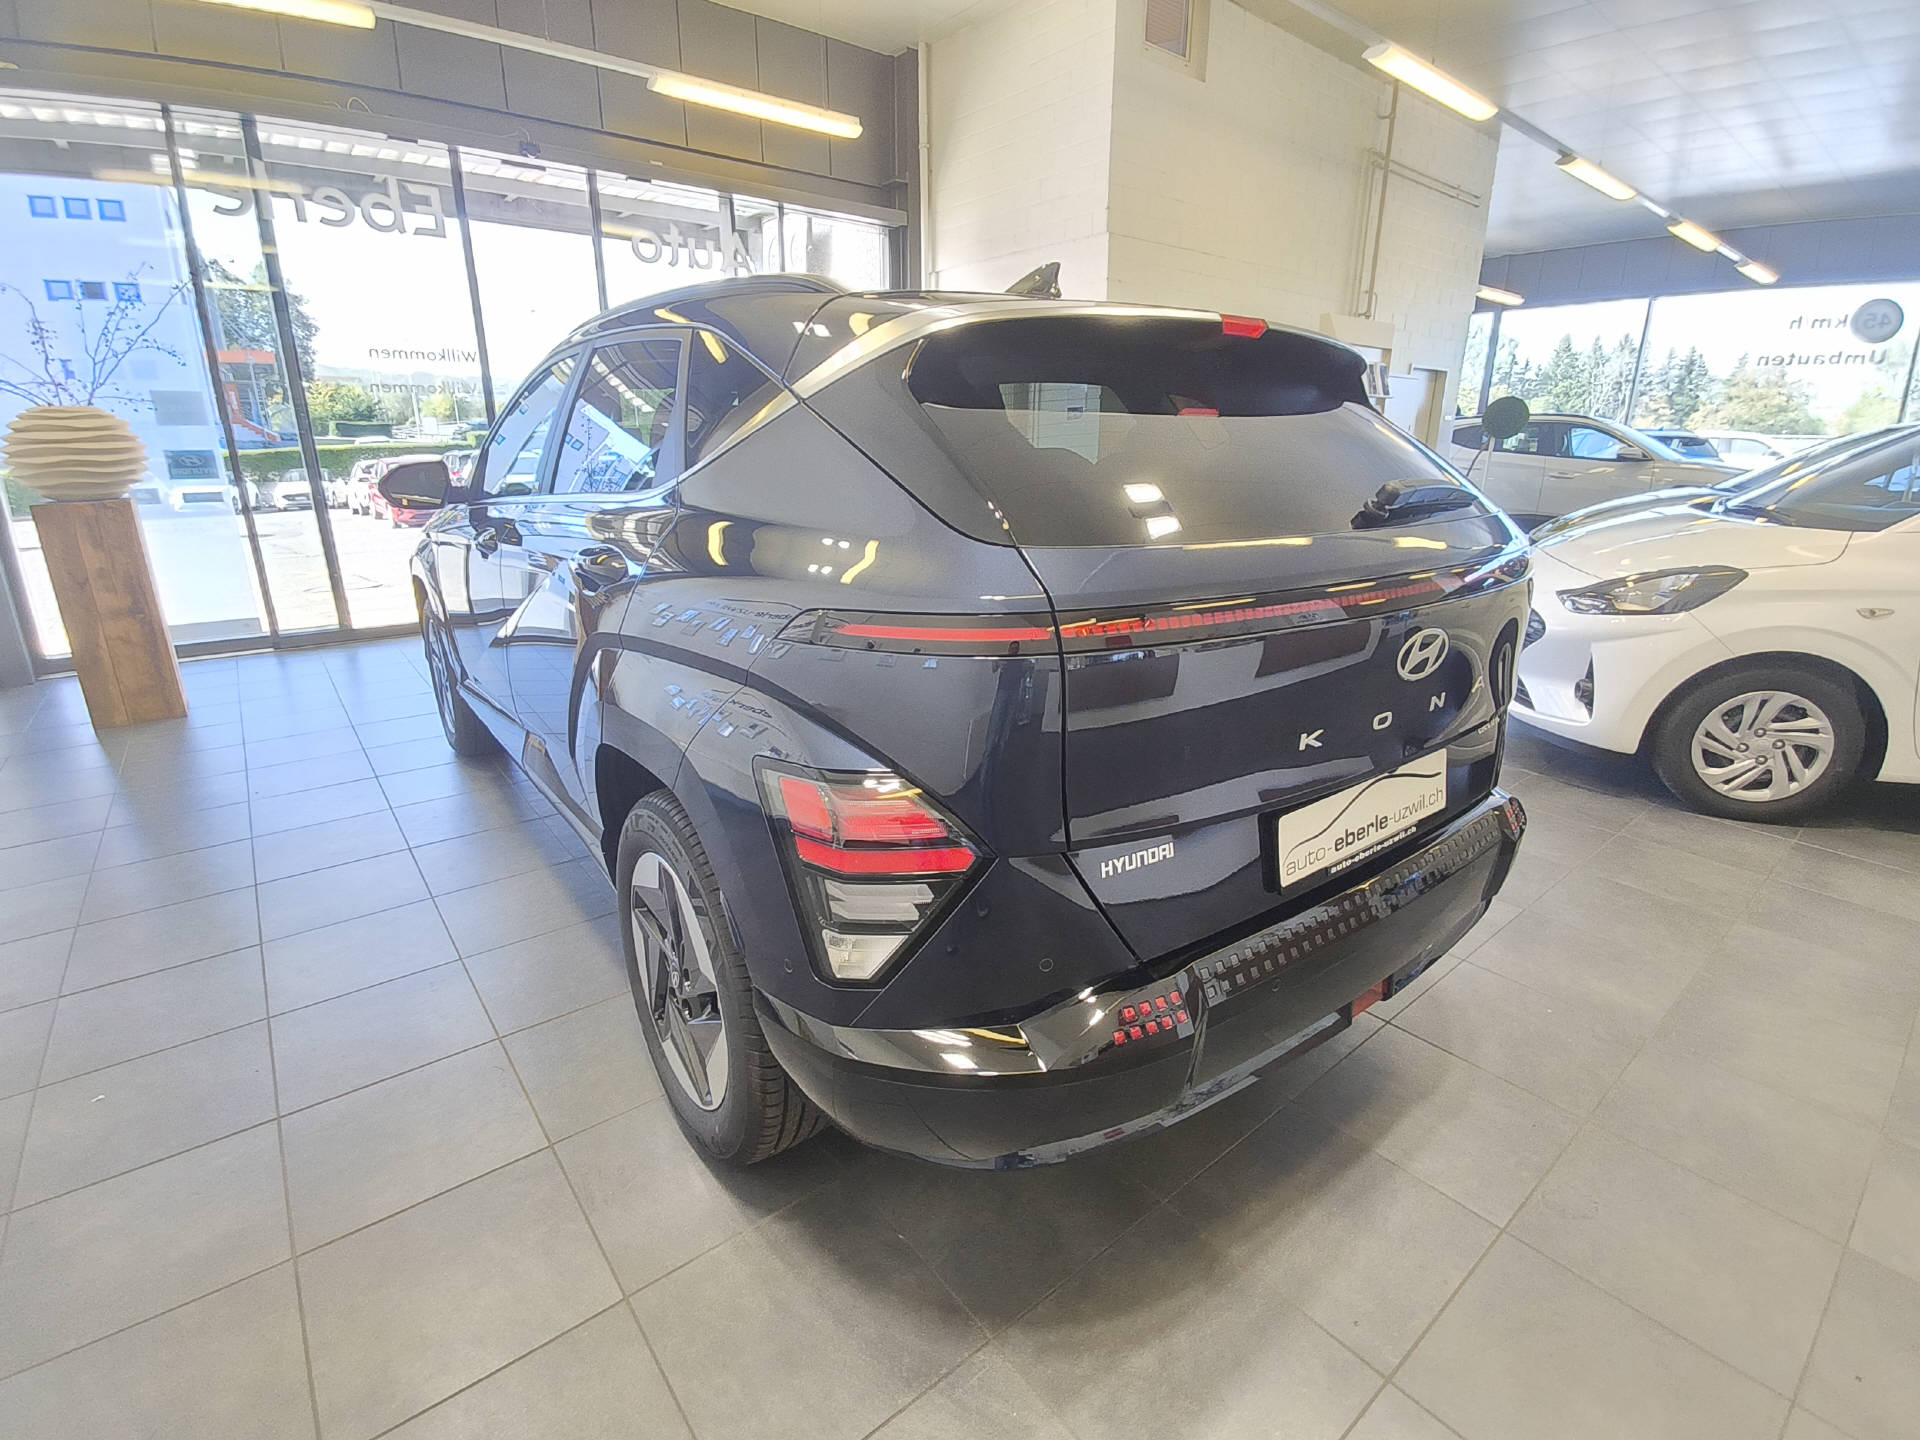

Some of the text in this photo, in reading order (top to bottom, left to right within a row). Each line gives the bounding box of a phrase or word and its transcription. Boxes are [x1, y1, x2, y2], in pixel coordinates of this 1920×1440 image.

[1285, 787, 1444, 877] auto-eberle-uzwil.ch
[1330, 826, 1417, 875] auto-eberle-uzwil.ch
[1101, 842, 1175, 879] HYUNDAI
